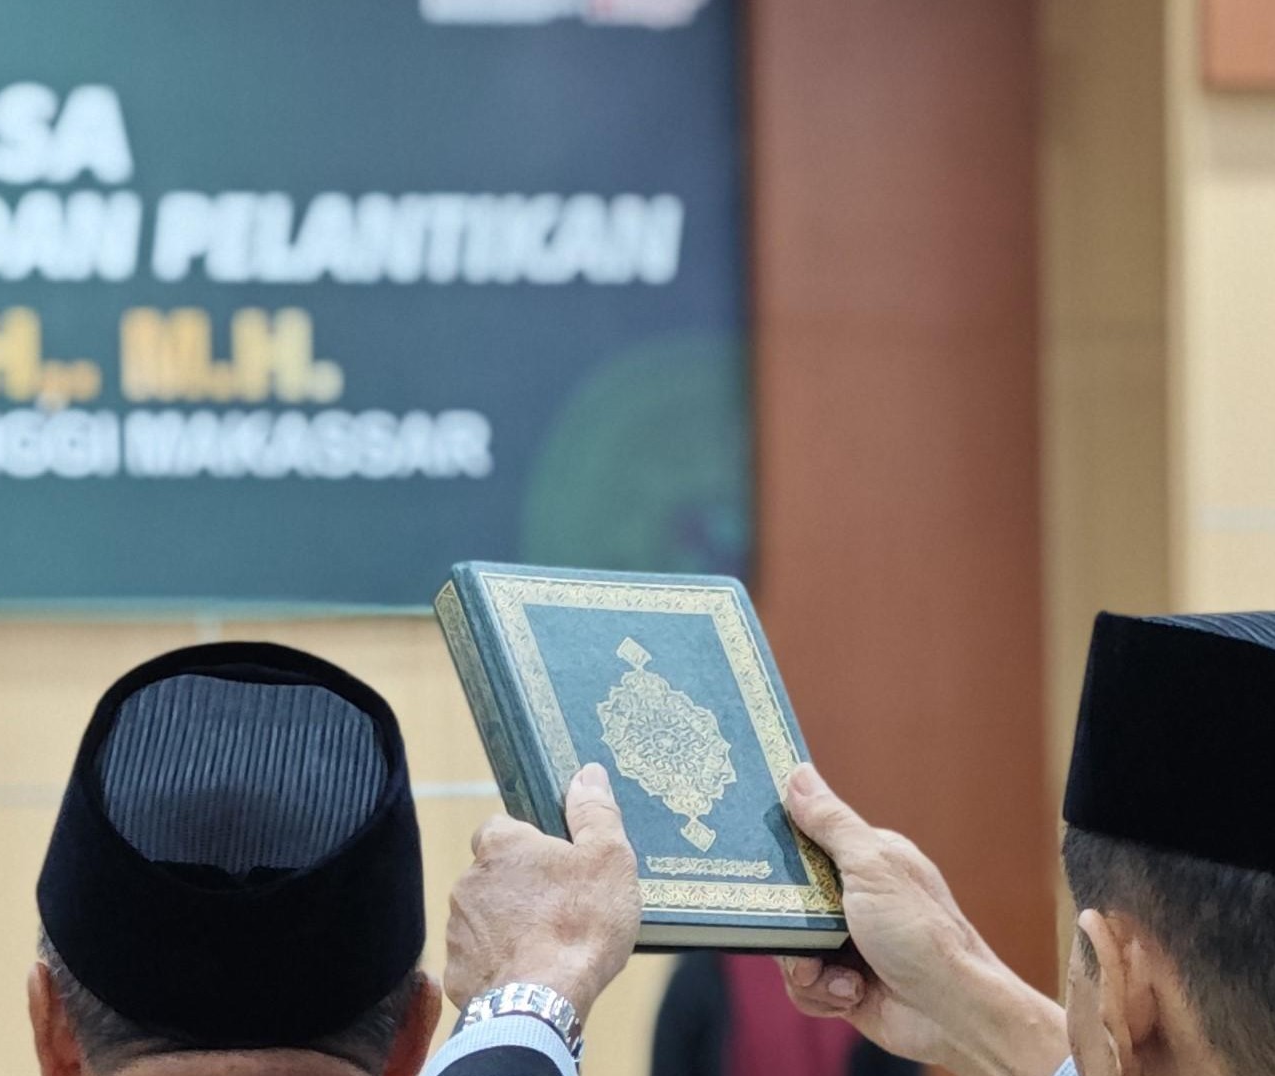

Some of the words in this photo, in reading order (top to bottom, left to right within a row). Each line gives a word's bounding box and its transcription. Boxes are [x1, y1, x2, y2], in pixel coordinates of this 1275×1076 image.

[152, 192, 682, 286] PELANTIKAN
[120, 306, 344, 402] M.H.
[126, 410, 491, 480] MAKASSAR
